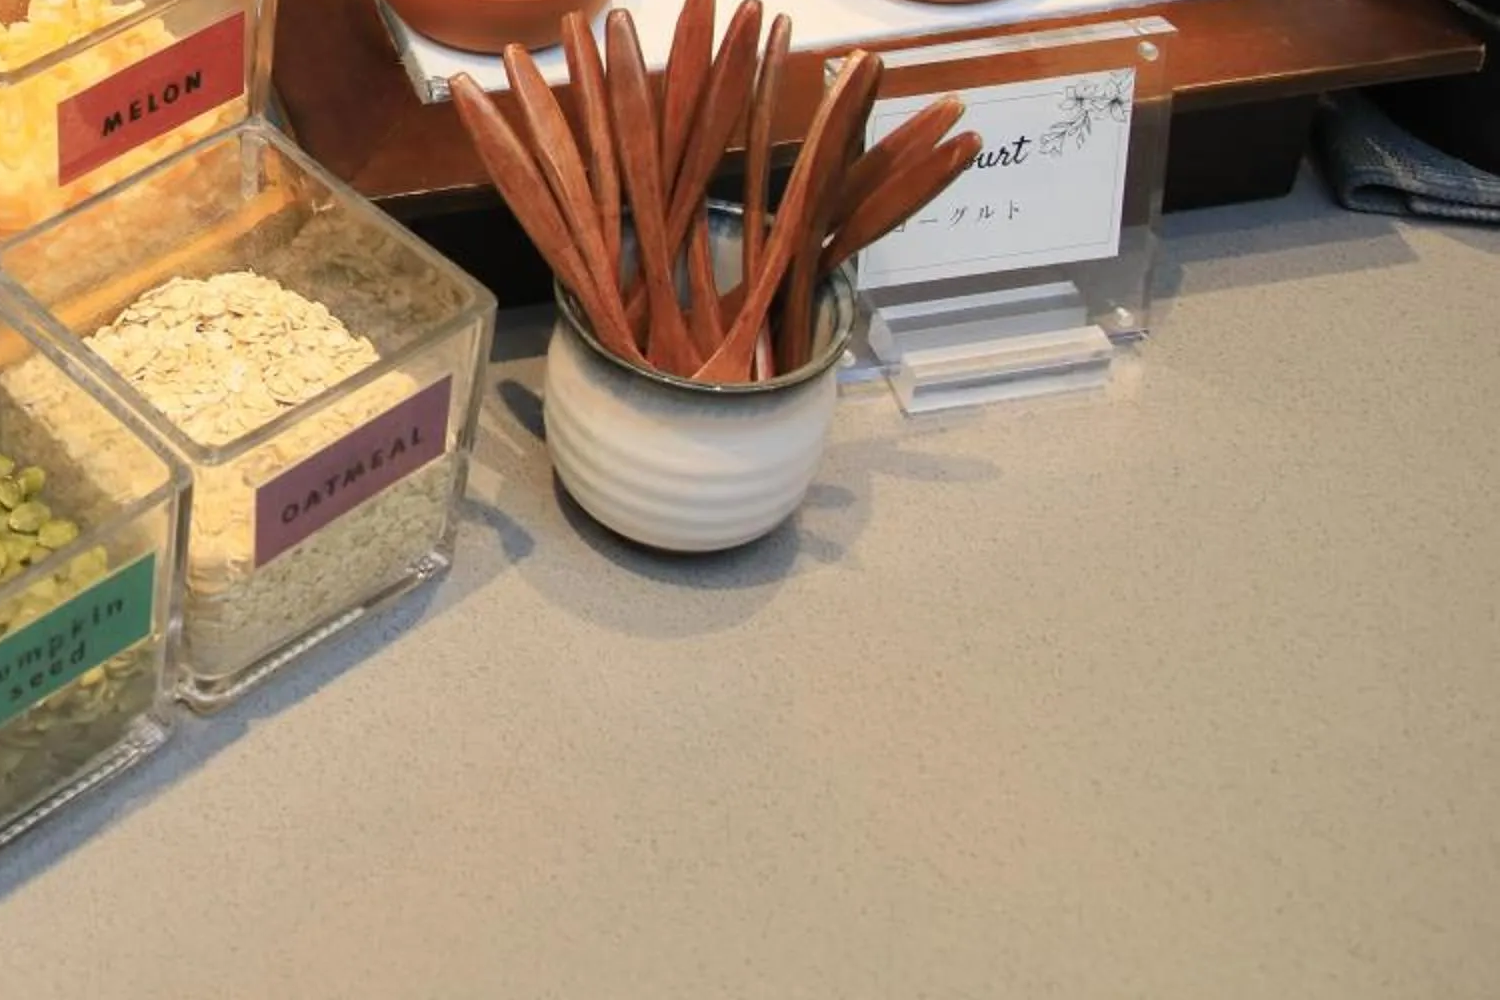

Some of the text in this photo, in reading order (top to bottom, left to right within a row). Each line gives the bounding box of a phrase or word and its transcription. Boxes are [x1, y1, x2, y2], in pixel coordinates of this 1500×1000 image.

[102, 69, 203, 137] MELON
[281, 426, 422, 524] OATMEAL
[10, 641, 85, 699] seed
